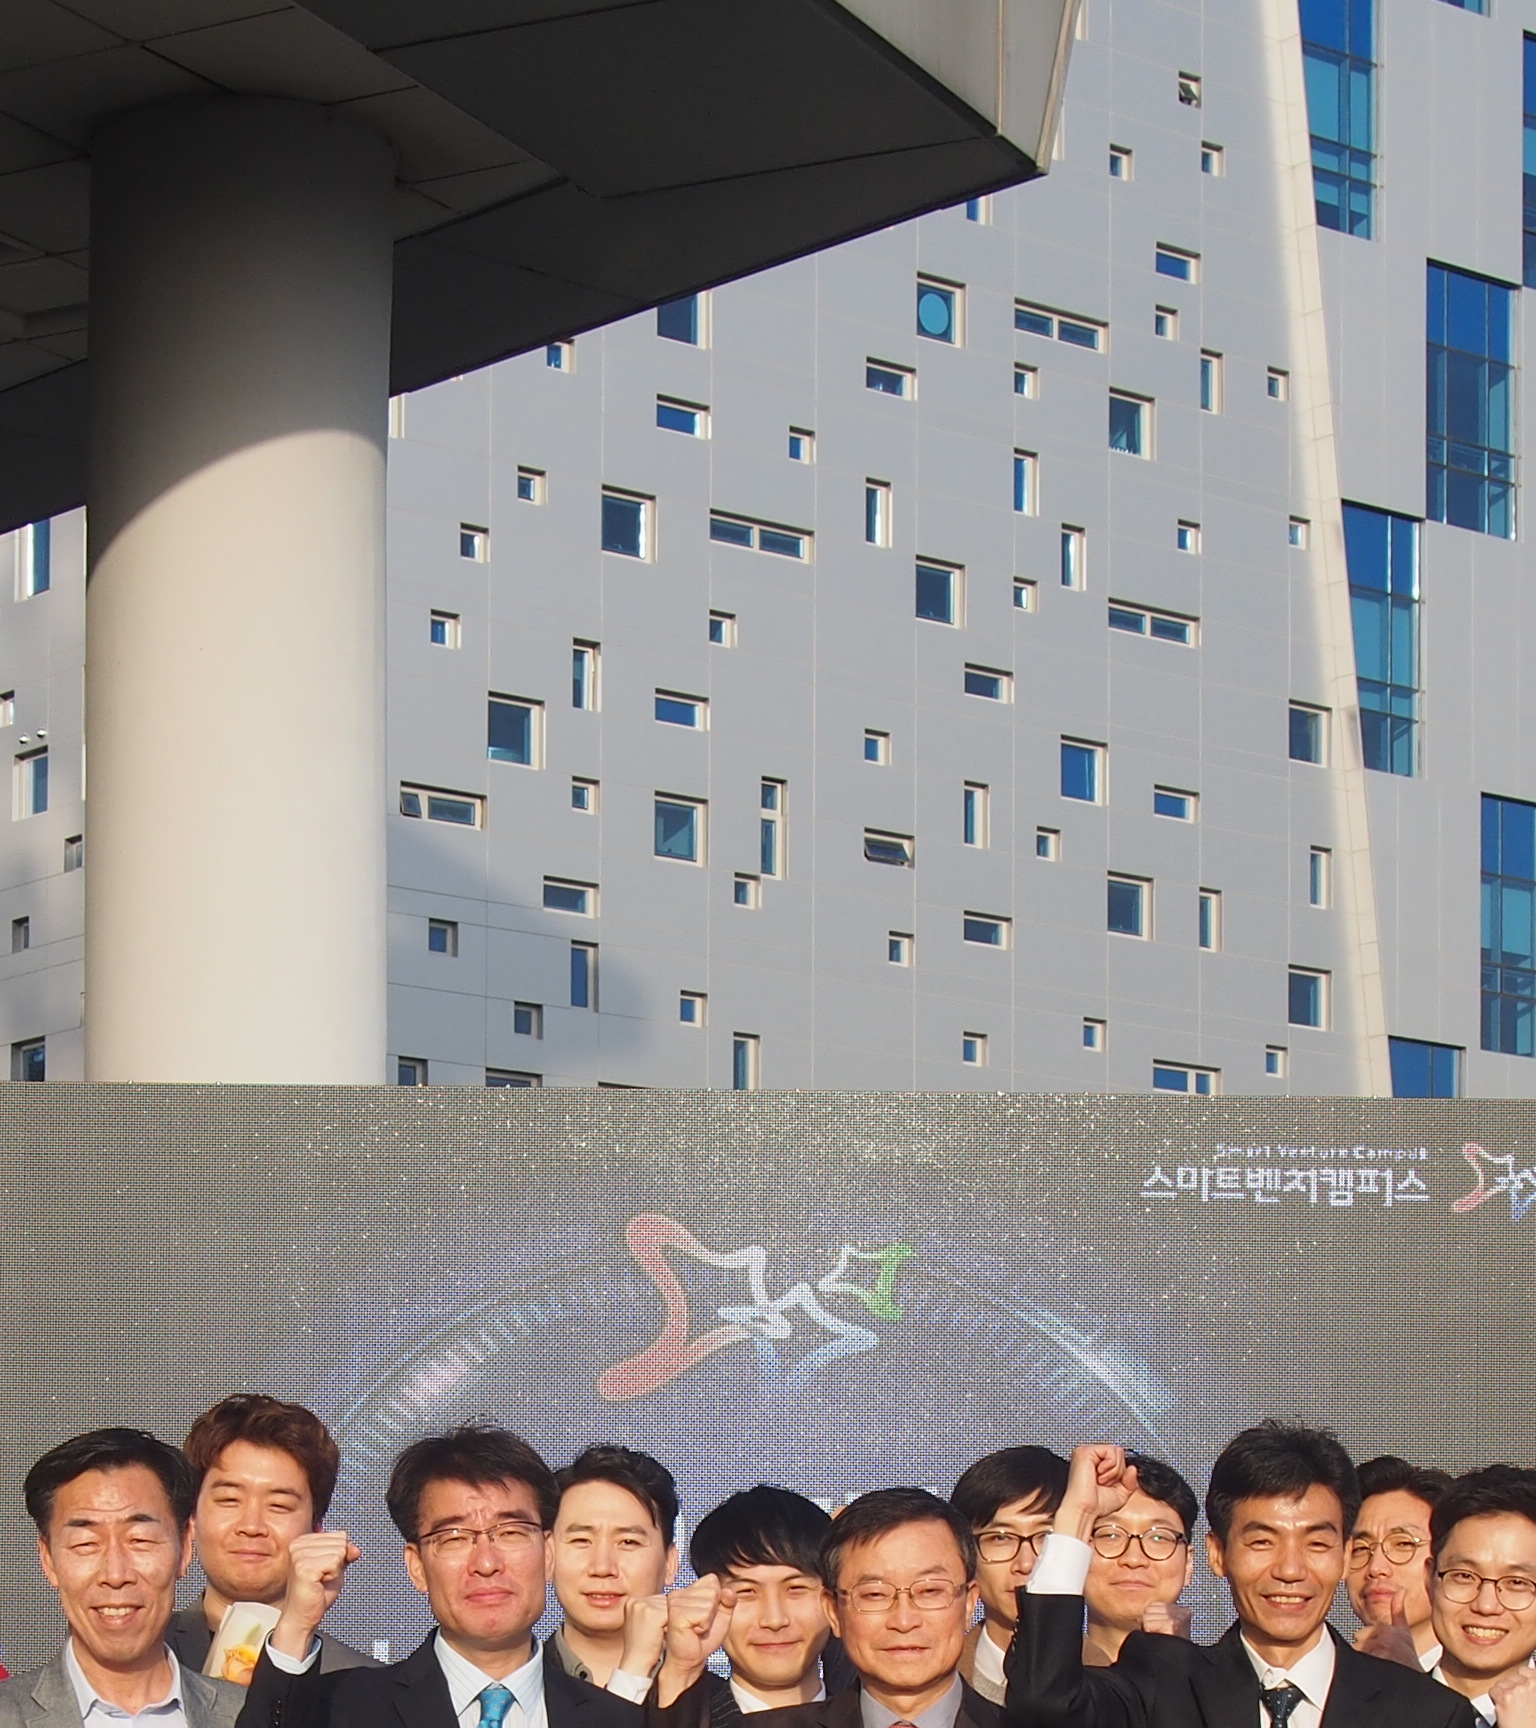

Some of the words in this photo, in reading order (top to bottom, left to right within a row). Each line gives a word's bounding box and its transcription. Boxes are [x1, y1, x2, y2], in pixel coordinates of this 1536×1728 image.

[1215, 1143, 1270, 1160] Smart
[1277, 1144, 1349, 1161] Venture
[1352, 1144, 1428, 1160] Campus
